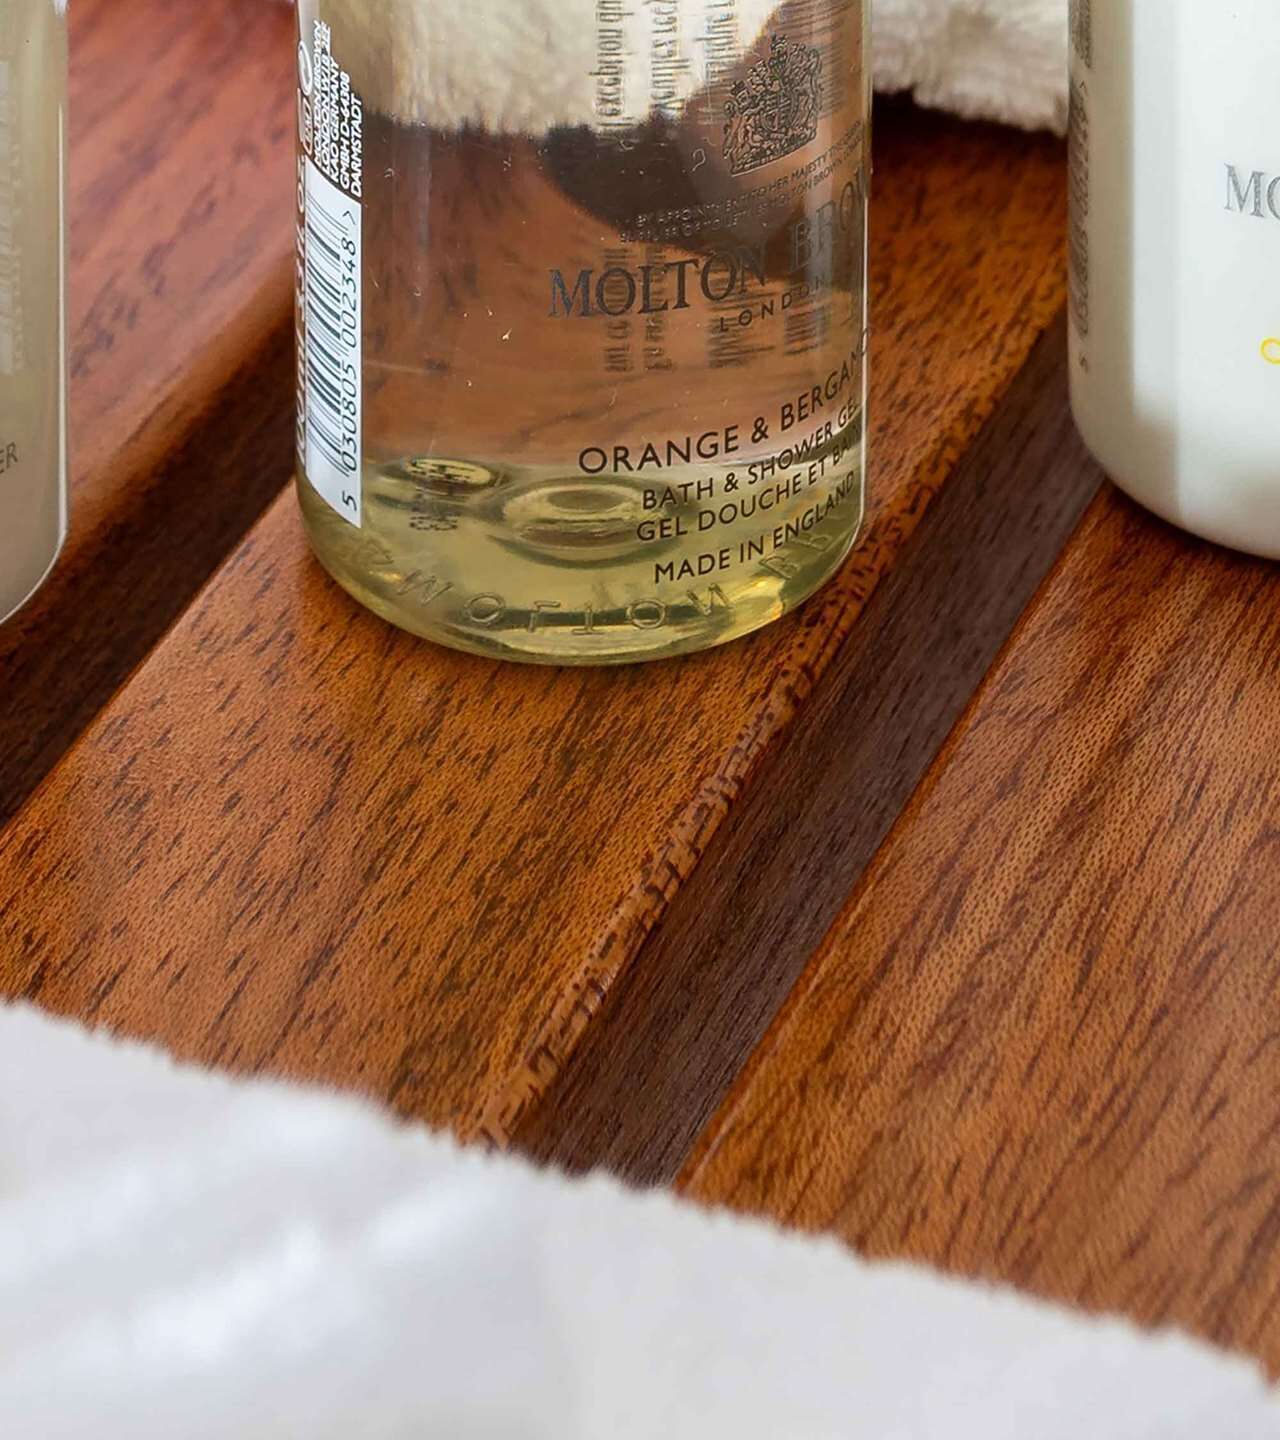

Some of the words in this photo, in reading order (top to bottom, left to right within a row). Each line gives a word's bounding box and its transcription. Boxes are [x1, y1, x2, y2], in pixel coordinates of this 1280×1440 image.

[330, 57, 339, 141] GERMANY
[330, 143, 339, 183] KAO
[340, 137, 350, 189] GMBH
[350, 93, 362, 197] DARMSTADT
[548, 245, 767, 318] MOLTON
[791, 166, 864, 272] BRO
[341, 237, 358, 348] 002348
[341, 362, 358, 472] 030805
[578, 425, 740, 474] ORANGE
[751, 416, 769, 444] &
[342, 491, 358, 511] 5
[636, 515, 688, 541] GEL
[698, 473, 802, 531] DOUCHE
[808, 455, 827, 486] ET
[642, 477, 714, 510] BATH
[724, 472, 739, 493] &
[748, 420, 833, 485] SHOWER
[654, 548, 731, 585] MADE
[740, 535, 764, 564] IN
[773, 470, 856, 549] ENGLAND
